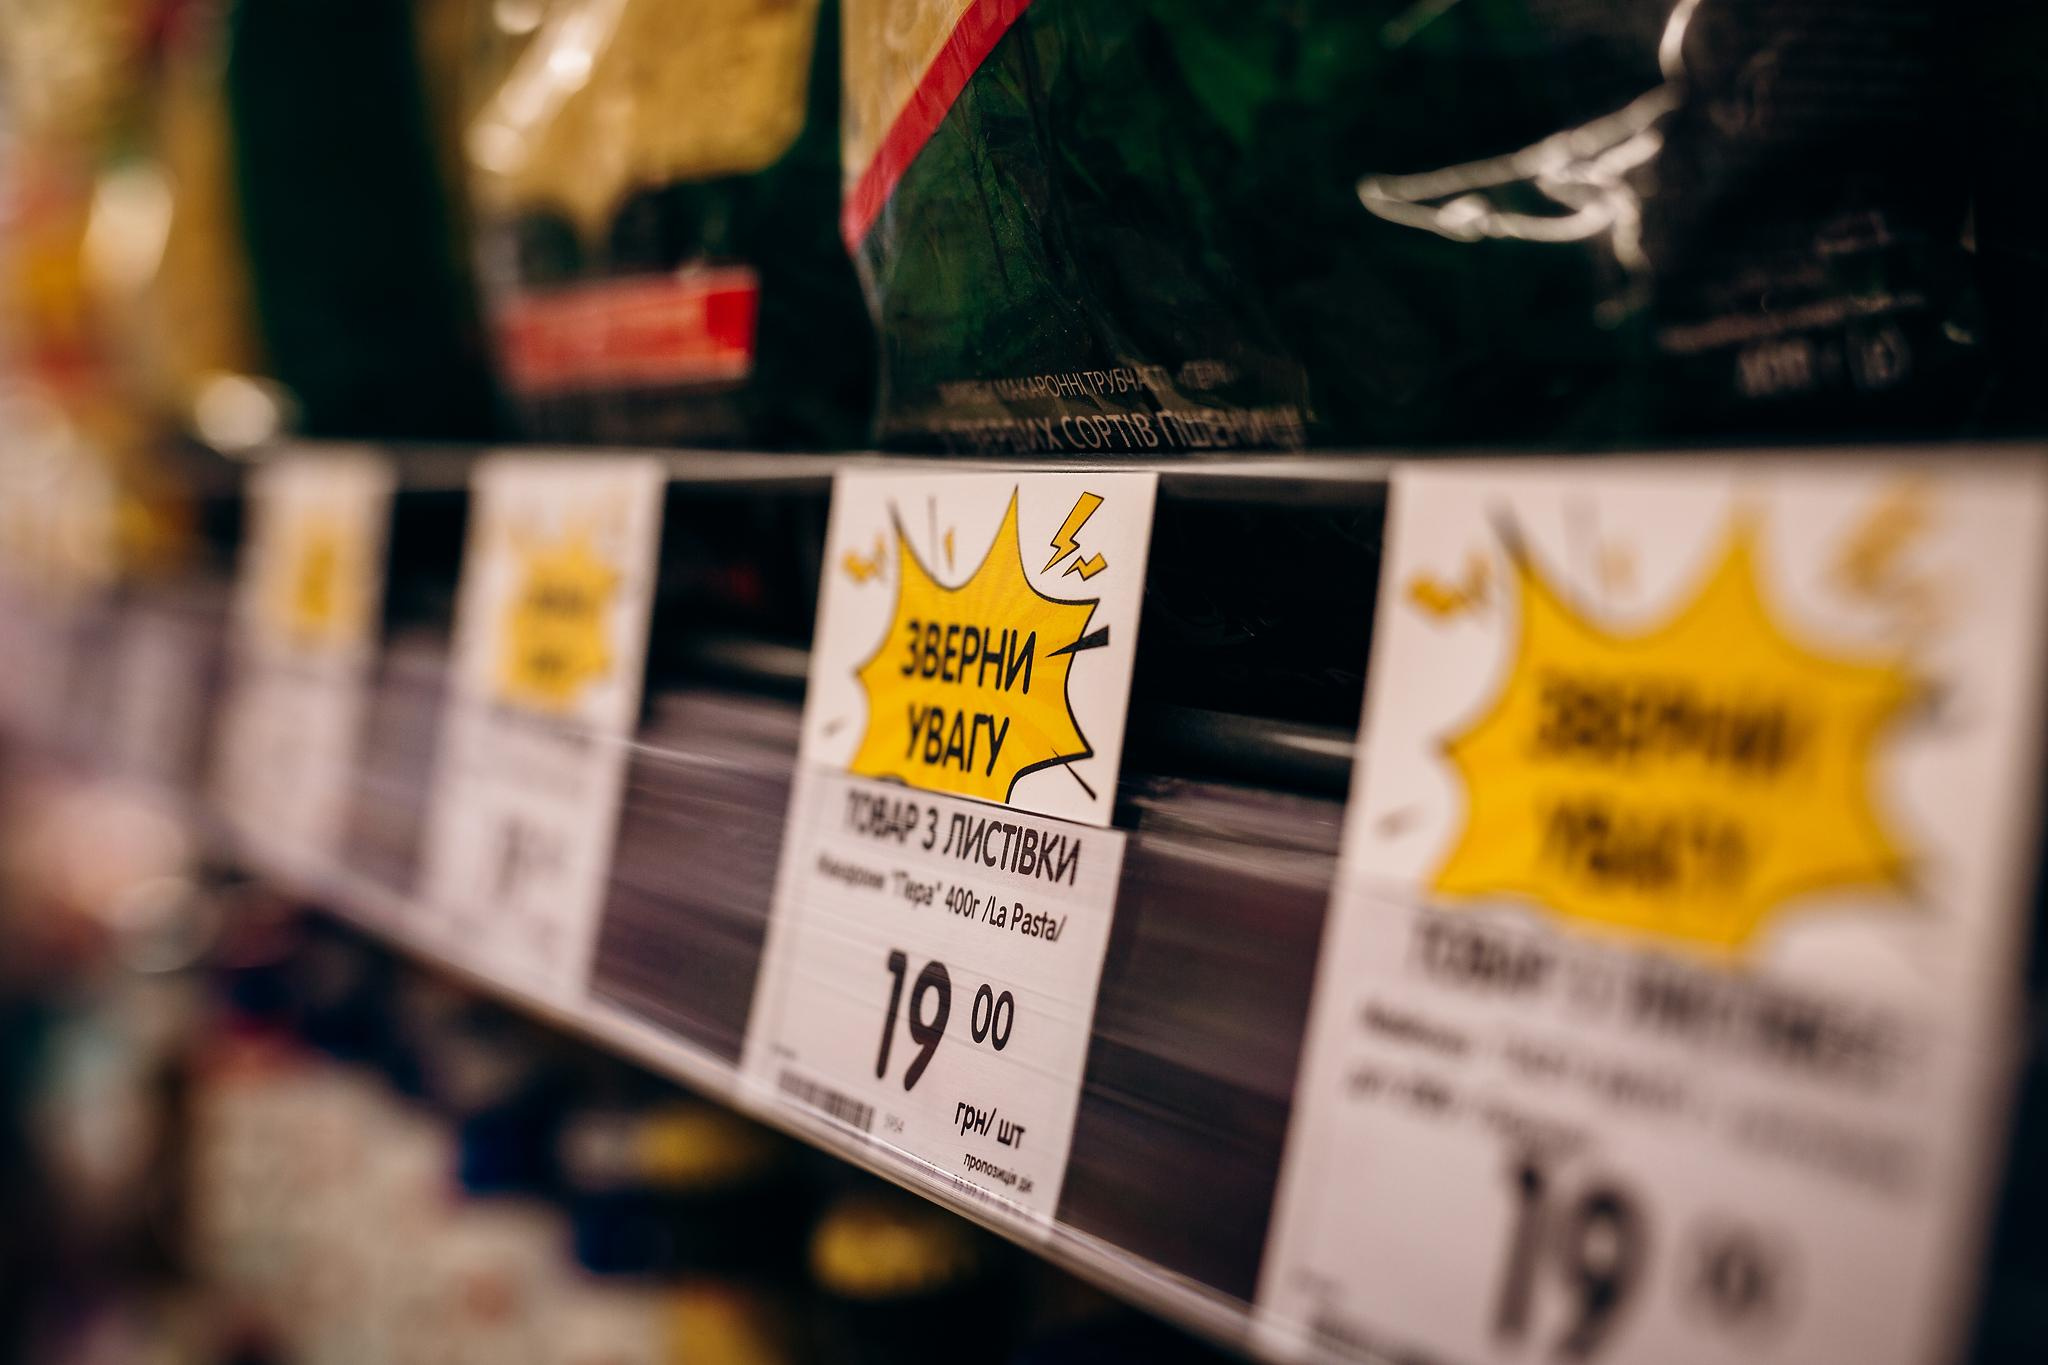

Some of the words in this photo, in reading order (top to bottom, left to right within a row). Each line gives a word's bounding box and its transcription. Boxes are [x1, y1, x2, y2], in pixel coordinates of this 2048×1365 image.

[1060, 411, 1159, 448] СОРТІВ
[901, 620, 1036, 695] ЗВЕРНИ
[906, 702, 1010, 777] УВАГУ
[943, 812, 1082, 887] ЛИСТІВКИ
[945, 885, 981, 920] 400г
[982, 895, 1007, 929] /La
[1010, 902, 1068, 943] Pasta/
[875, 948, 952, 1092] 19
[971, 983, 1015, 1052] 00
[955, 1101, 997, 1137] грн/
[997, 1118, 1026, 1149] шт
